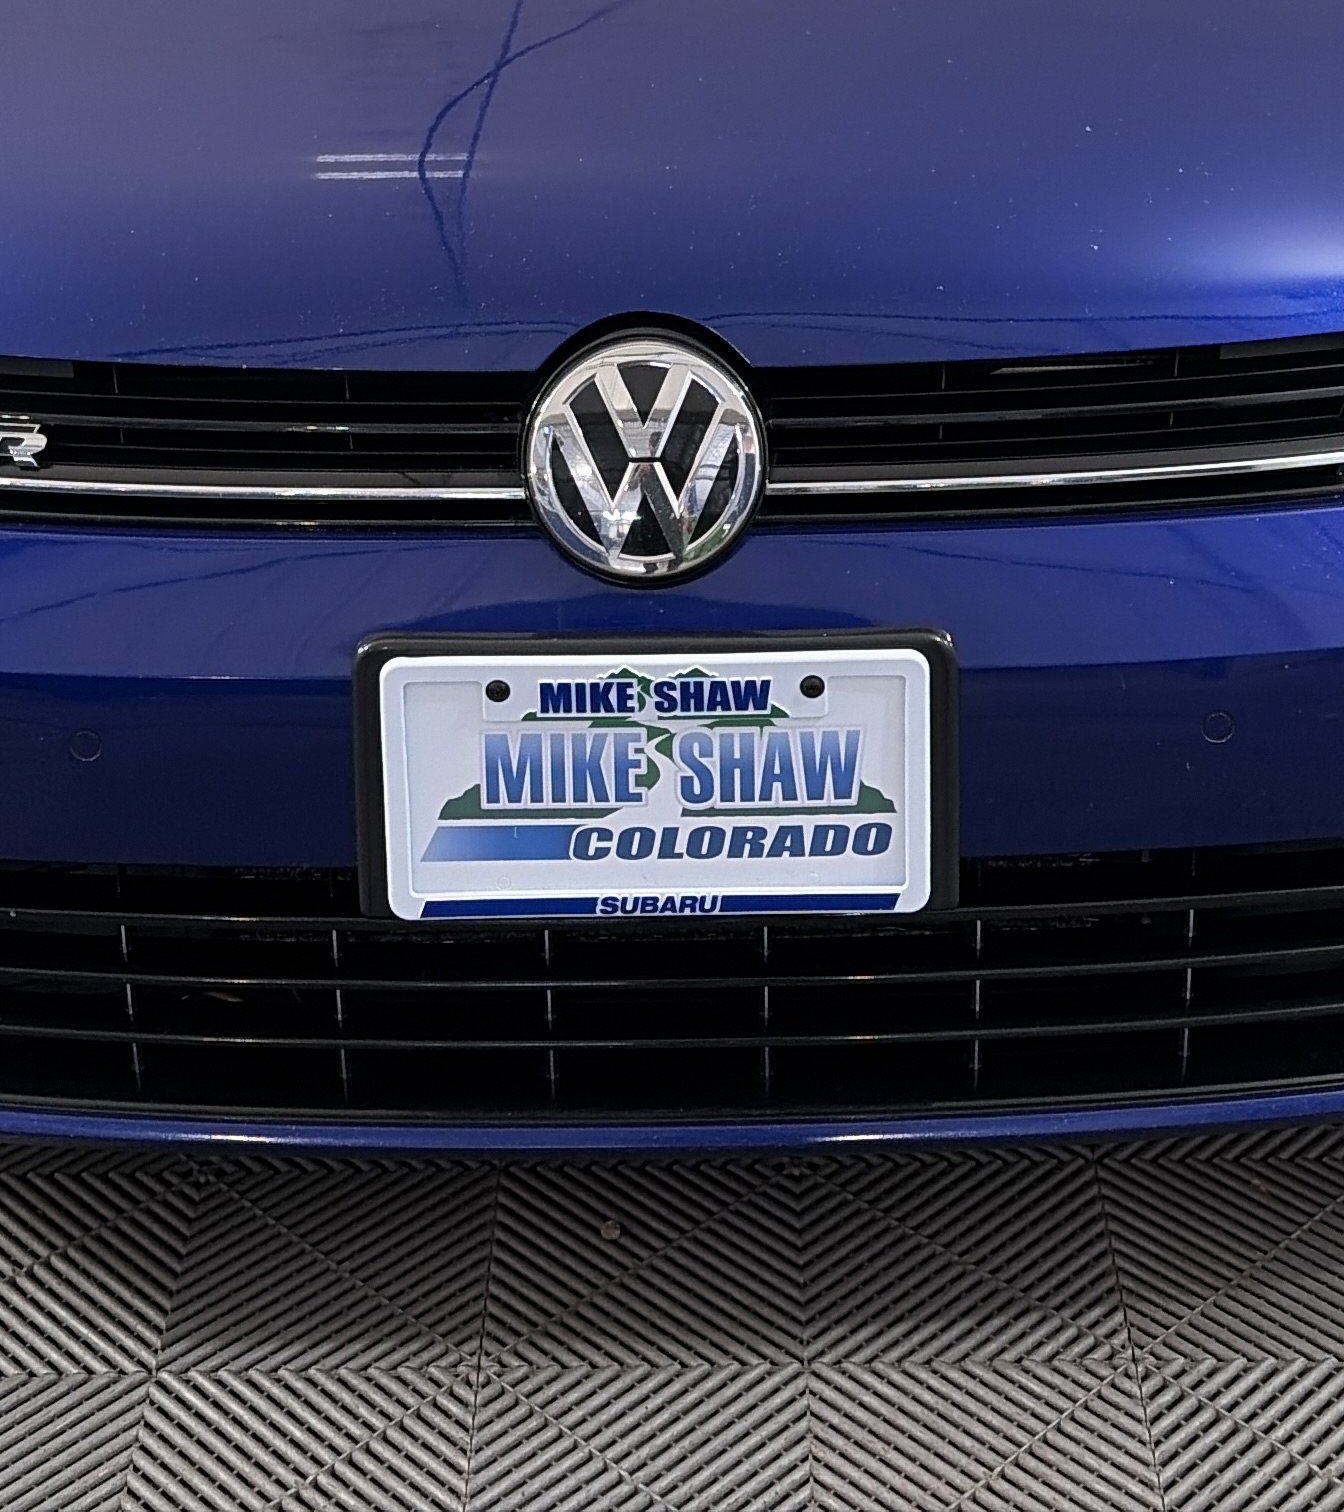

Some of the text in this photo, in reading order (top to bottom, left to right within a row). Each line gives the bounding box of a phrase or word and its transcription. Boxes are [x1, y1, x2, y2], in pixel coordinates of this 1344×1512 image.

[540, 680, 772, 713] MIKE SHAW
[485, 729, 861, 804] MIKE SHAW
[573, 822, 893, 860] COLORADO
[600, 894, 718, 914] SUBARU
